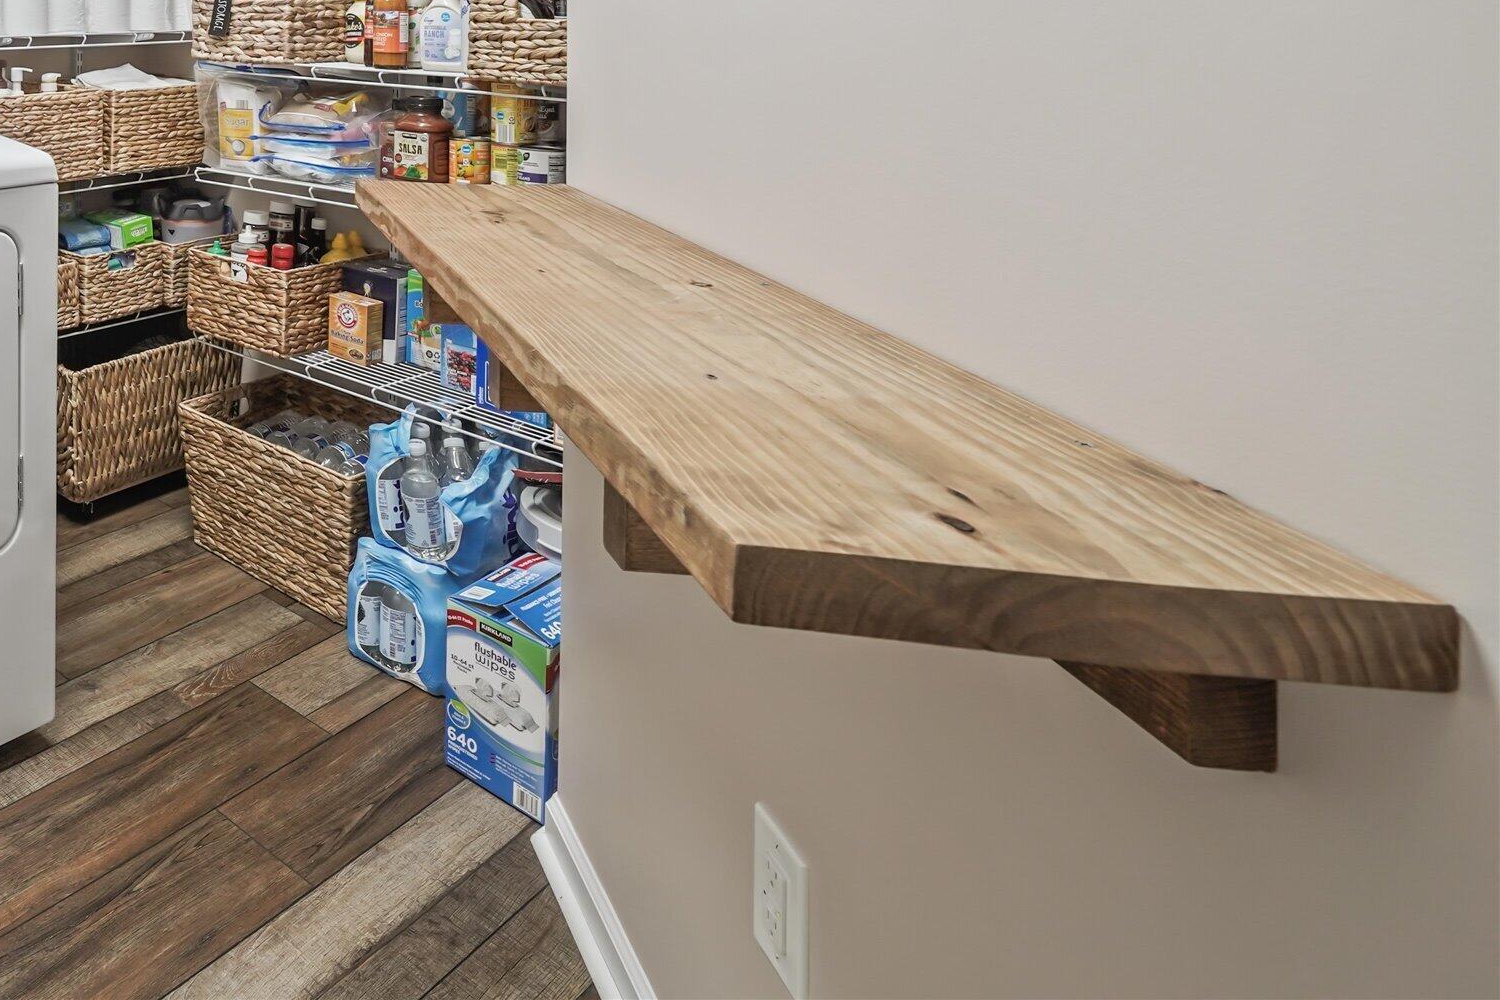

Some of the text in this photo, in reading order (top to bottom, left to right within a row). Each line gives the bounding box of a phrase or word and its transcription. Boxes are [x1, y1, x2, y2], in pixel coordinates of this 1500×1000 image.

[213, 0, 228, 30] STORAGE
[225, 116, 250, 128] Sugar
[398, 142, 423, 155] SALSA
[481, 623, 512, 643] KIRKLAND
[474, 641, 517, 671] flushable
[475, 653, 516, 681] wipes
[447, 726, 478, 754] 640
